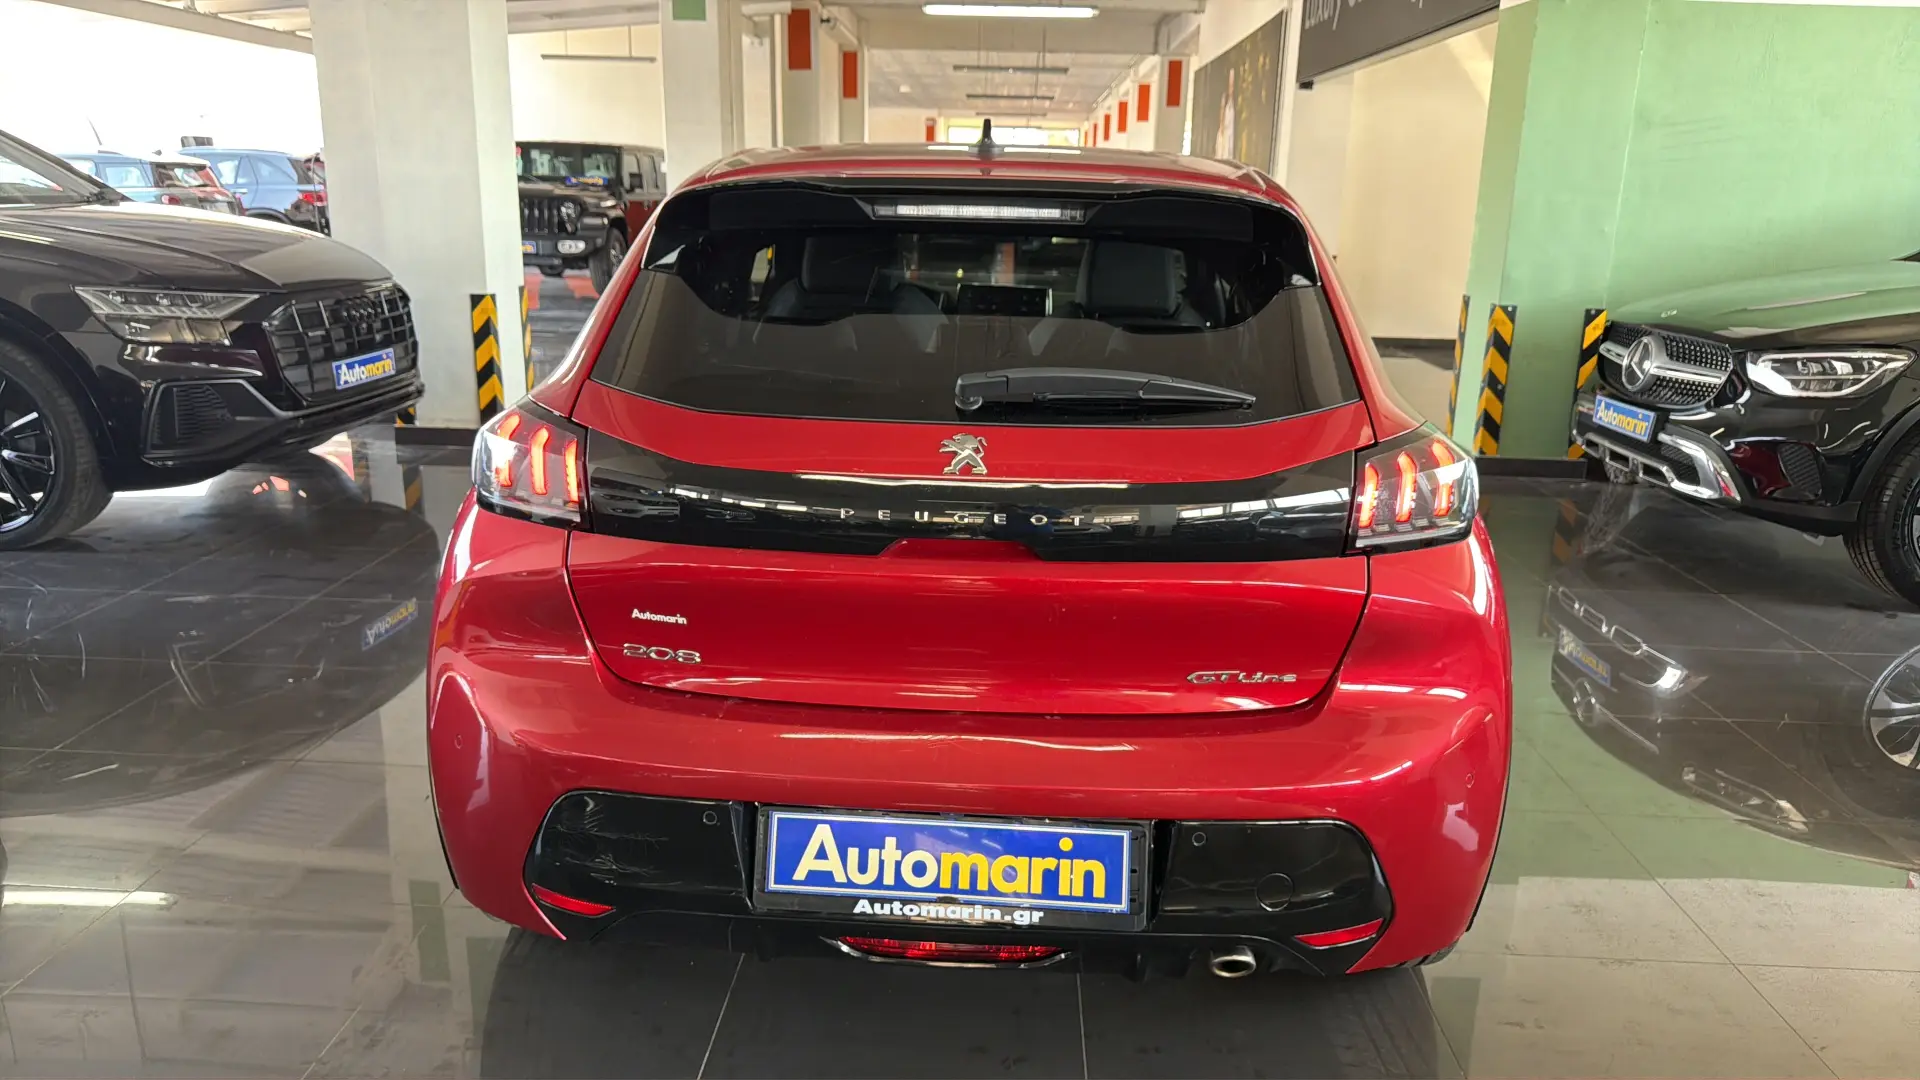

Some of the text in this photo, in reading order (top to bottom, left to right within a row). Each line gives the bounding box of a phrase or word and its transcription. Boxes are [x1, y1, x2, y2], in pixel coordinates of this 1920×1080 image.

[339, 354, 393, 386] Automarin
[1597, 400, 1648, 436] Automarin
[840, 507, 1084, 526] PEUGEOT
[631, 608, 688, 625] Automarin
[623, 643, 701, 664] 208
[792, 824, 1107, 899] Automarin
[852, 899, 1045, 926] Automarin.gr
